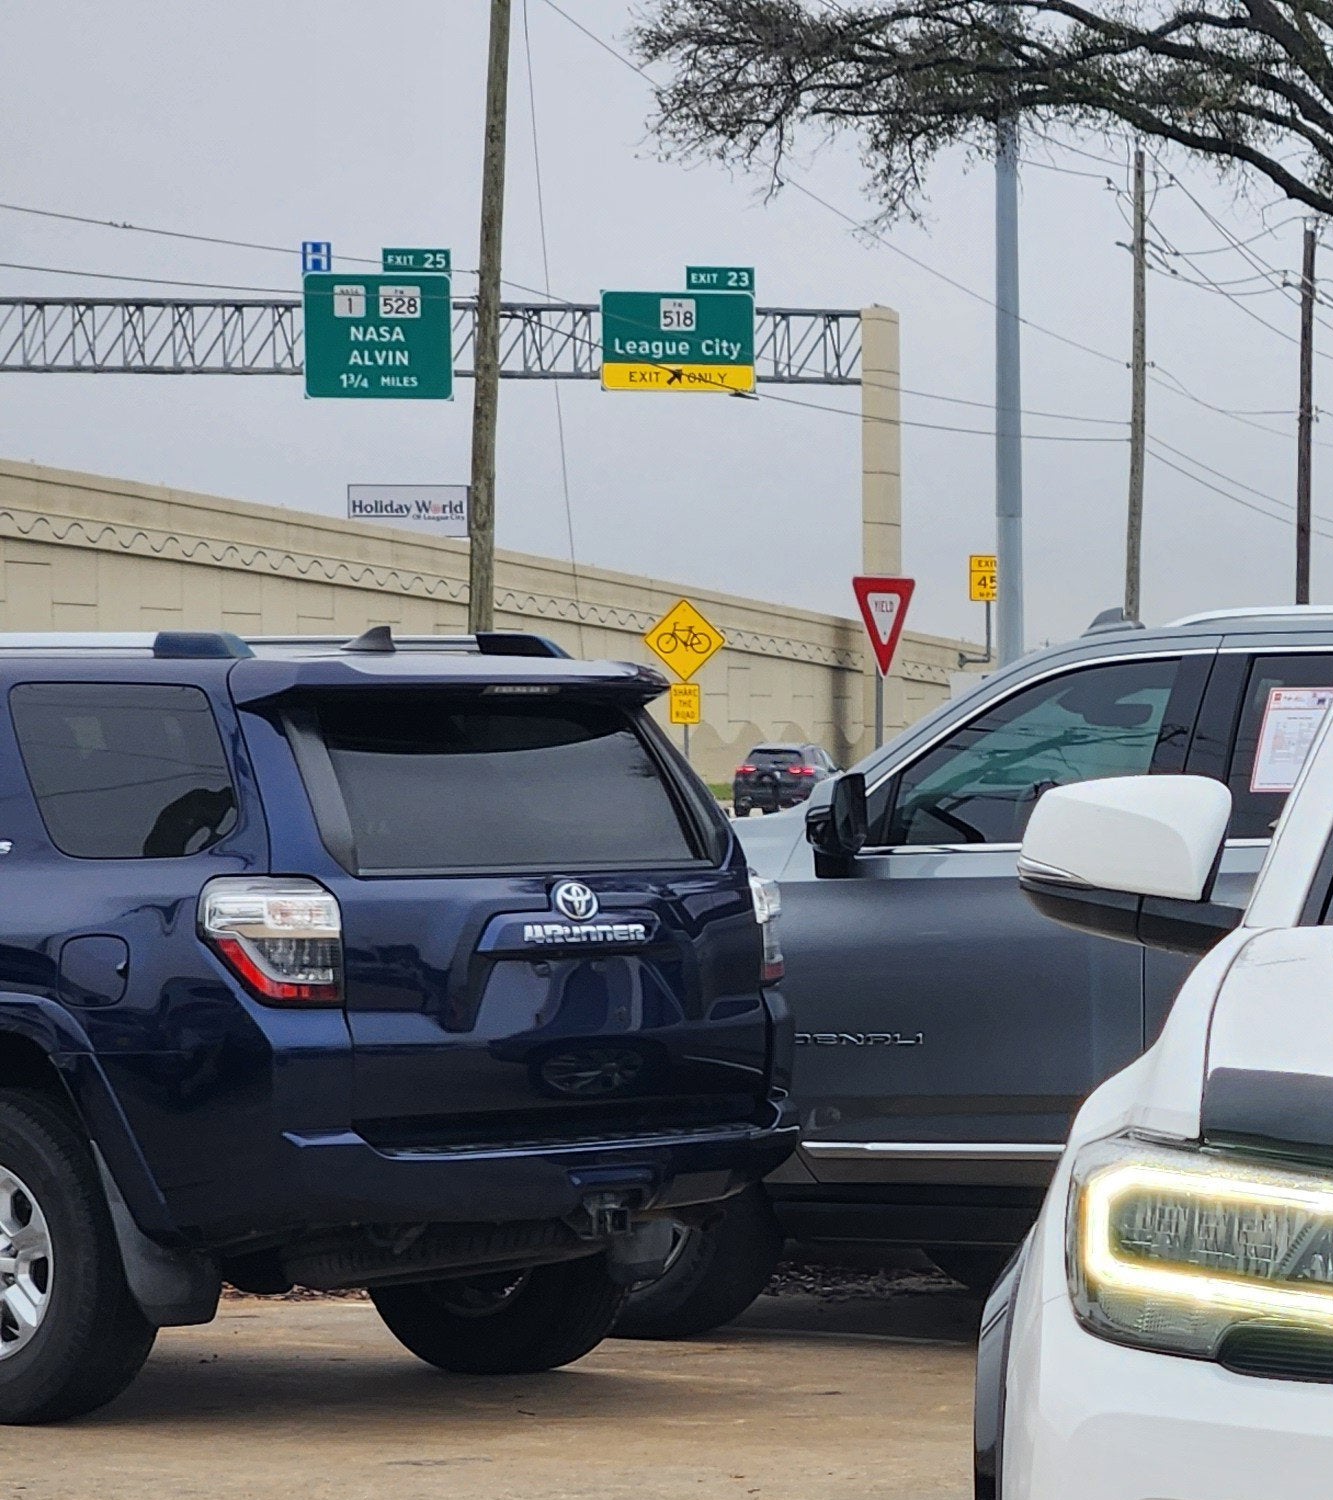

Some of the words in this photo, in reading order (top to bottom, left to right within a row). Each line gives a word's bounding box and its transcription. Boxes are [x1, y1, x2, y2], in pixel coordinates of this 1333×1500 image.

[387, 255, 414, 266] EXIT
[423, 253, 446, 269] 25
[690, 273, 718, 284] EXIT
[727, 272, 750, 287] 23
[347, 298, 353, 314] 1
[383, 298, 418, 315] 528
[663, 311, 694, 328] 518
[350, 326, 406, 343] NASA
[614, 338, 690, 359] League
[701, 338, 742, 360] City
[349, 350, 410, 366] ALVIN
[380, 376, 418, 387] MILES
[629, 371, 661, 383] EXIT
[352, 500, 411, 518] Holiday
[415, 500, 464, 514] World
[977, 576, 997, 590] 45
[874, 600, 894, 613] YIELD
[679, 700, 692, 708] THE
